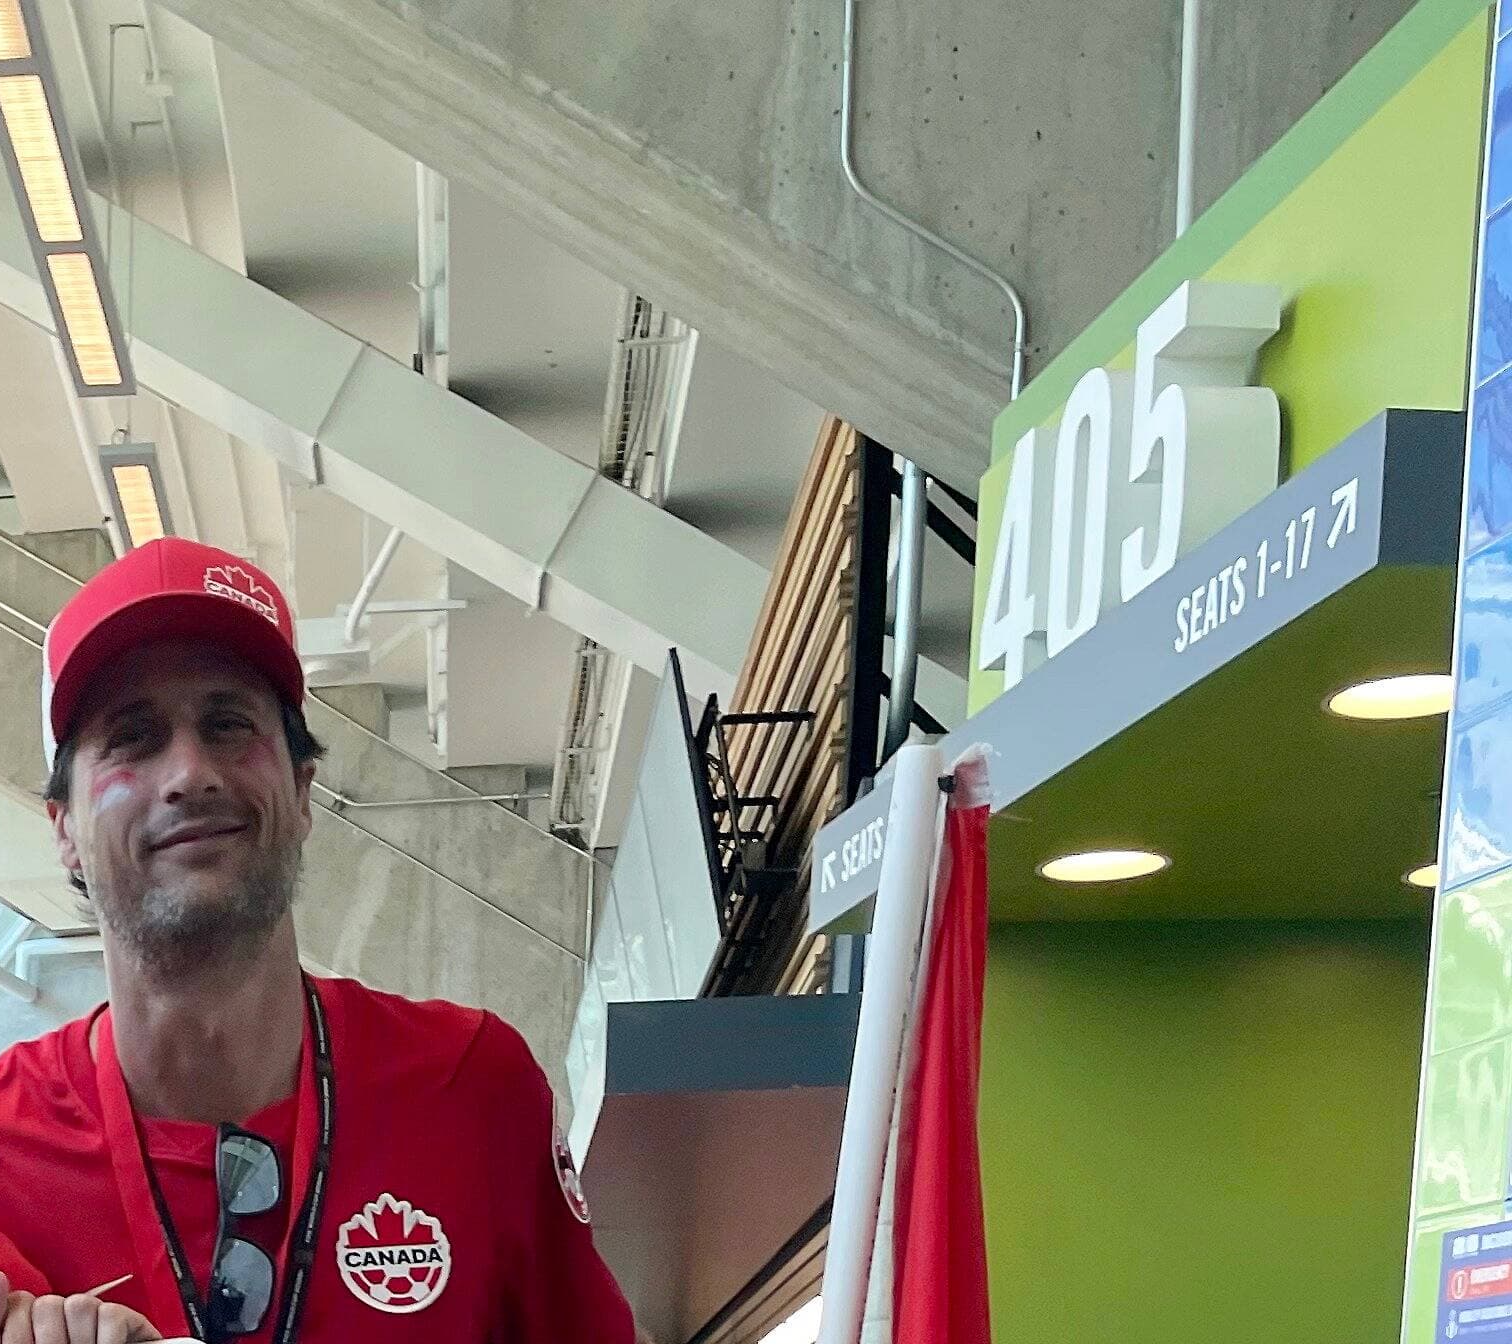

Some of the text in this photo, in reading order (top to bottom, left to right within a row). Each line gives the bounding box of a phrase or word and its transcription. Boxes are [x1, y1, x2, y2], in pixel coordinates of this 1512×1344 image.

[979, 281, 1191, 694] 405
[206, 581, 278, 622] CANADA
[1173, 505, 1314, 655] SEATS 1-17
[841, 816, 884, 882] SEATS
[345, 1247, 443, 1268] CANADA
